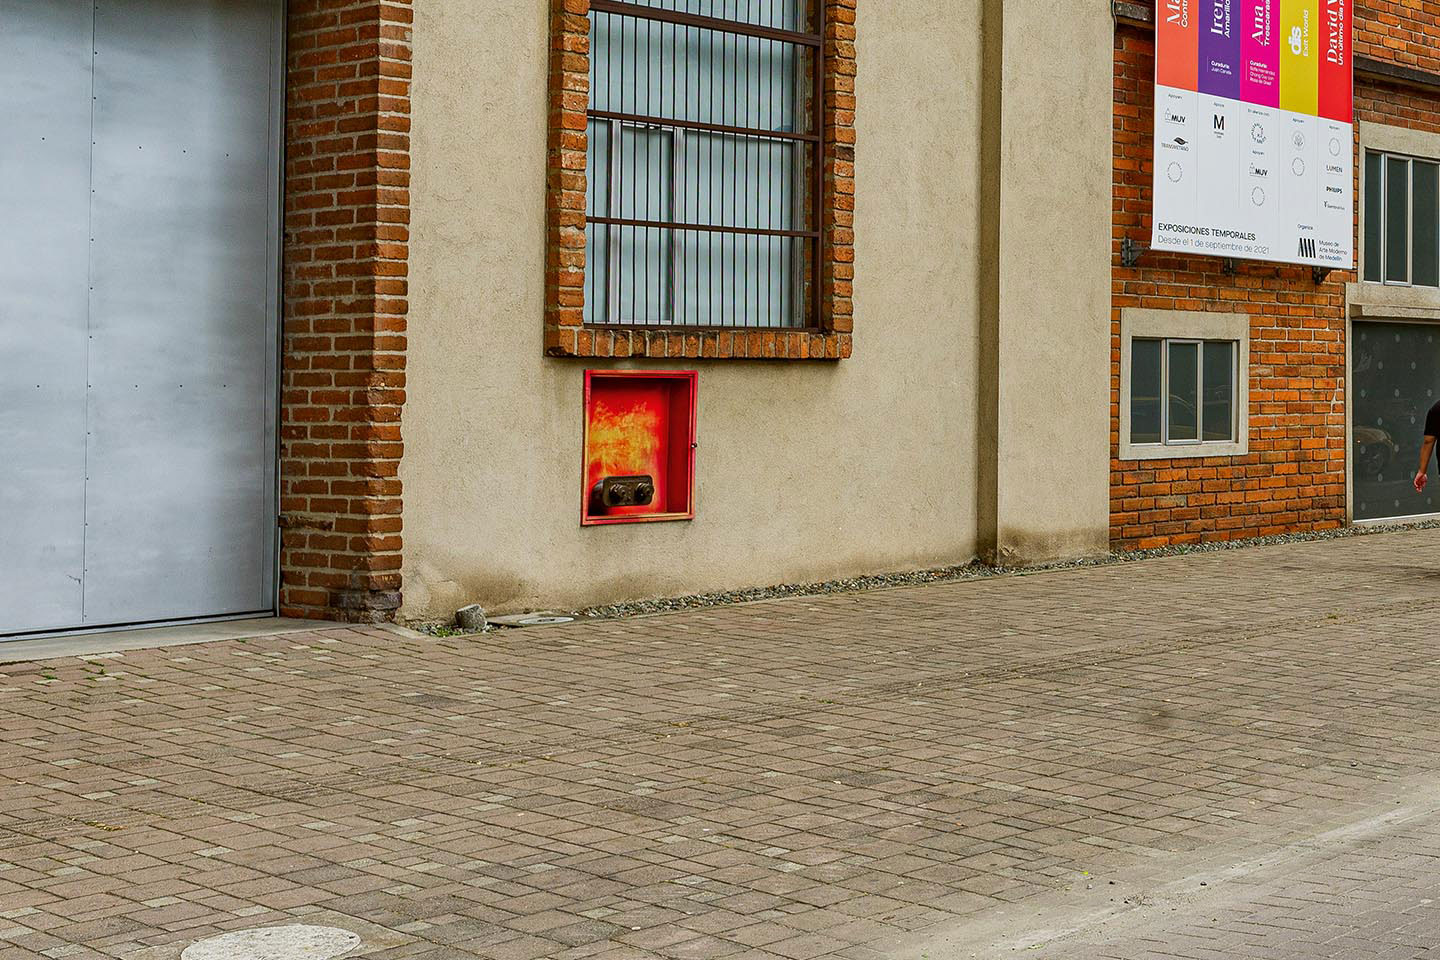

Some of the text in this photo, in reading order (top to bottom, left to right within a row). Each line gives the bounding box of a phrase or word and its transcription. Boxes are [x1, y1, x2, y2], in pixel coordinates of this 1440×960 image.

[1251, 5, 1265, 46] Ana
[1326, 9, 1338, 64] David
[1213, 114, 1225, 130] M
[1326, 164, 1343, 173] LUMEN
[1326, 186, 1343, 194] PHILIPS
[1158, 222, 1256, 241] EXPOSICIONES TEMPORALES
[1157, 235, 1181, 245] Desde
[1194, 239, 1204, 247] de
[1205, 241, 1243, 251] septiembre
[1244, 244, 1253, 252] de
[1253, 245, 1270, 255] 2021
